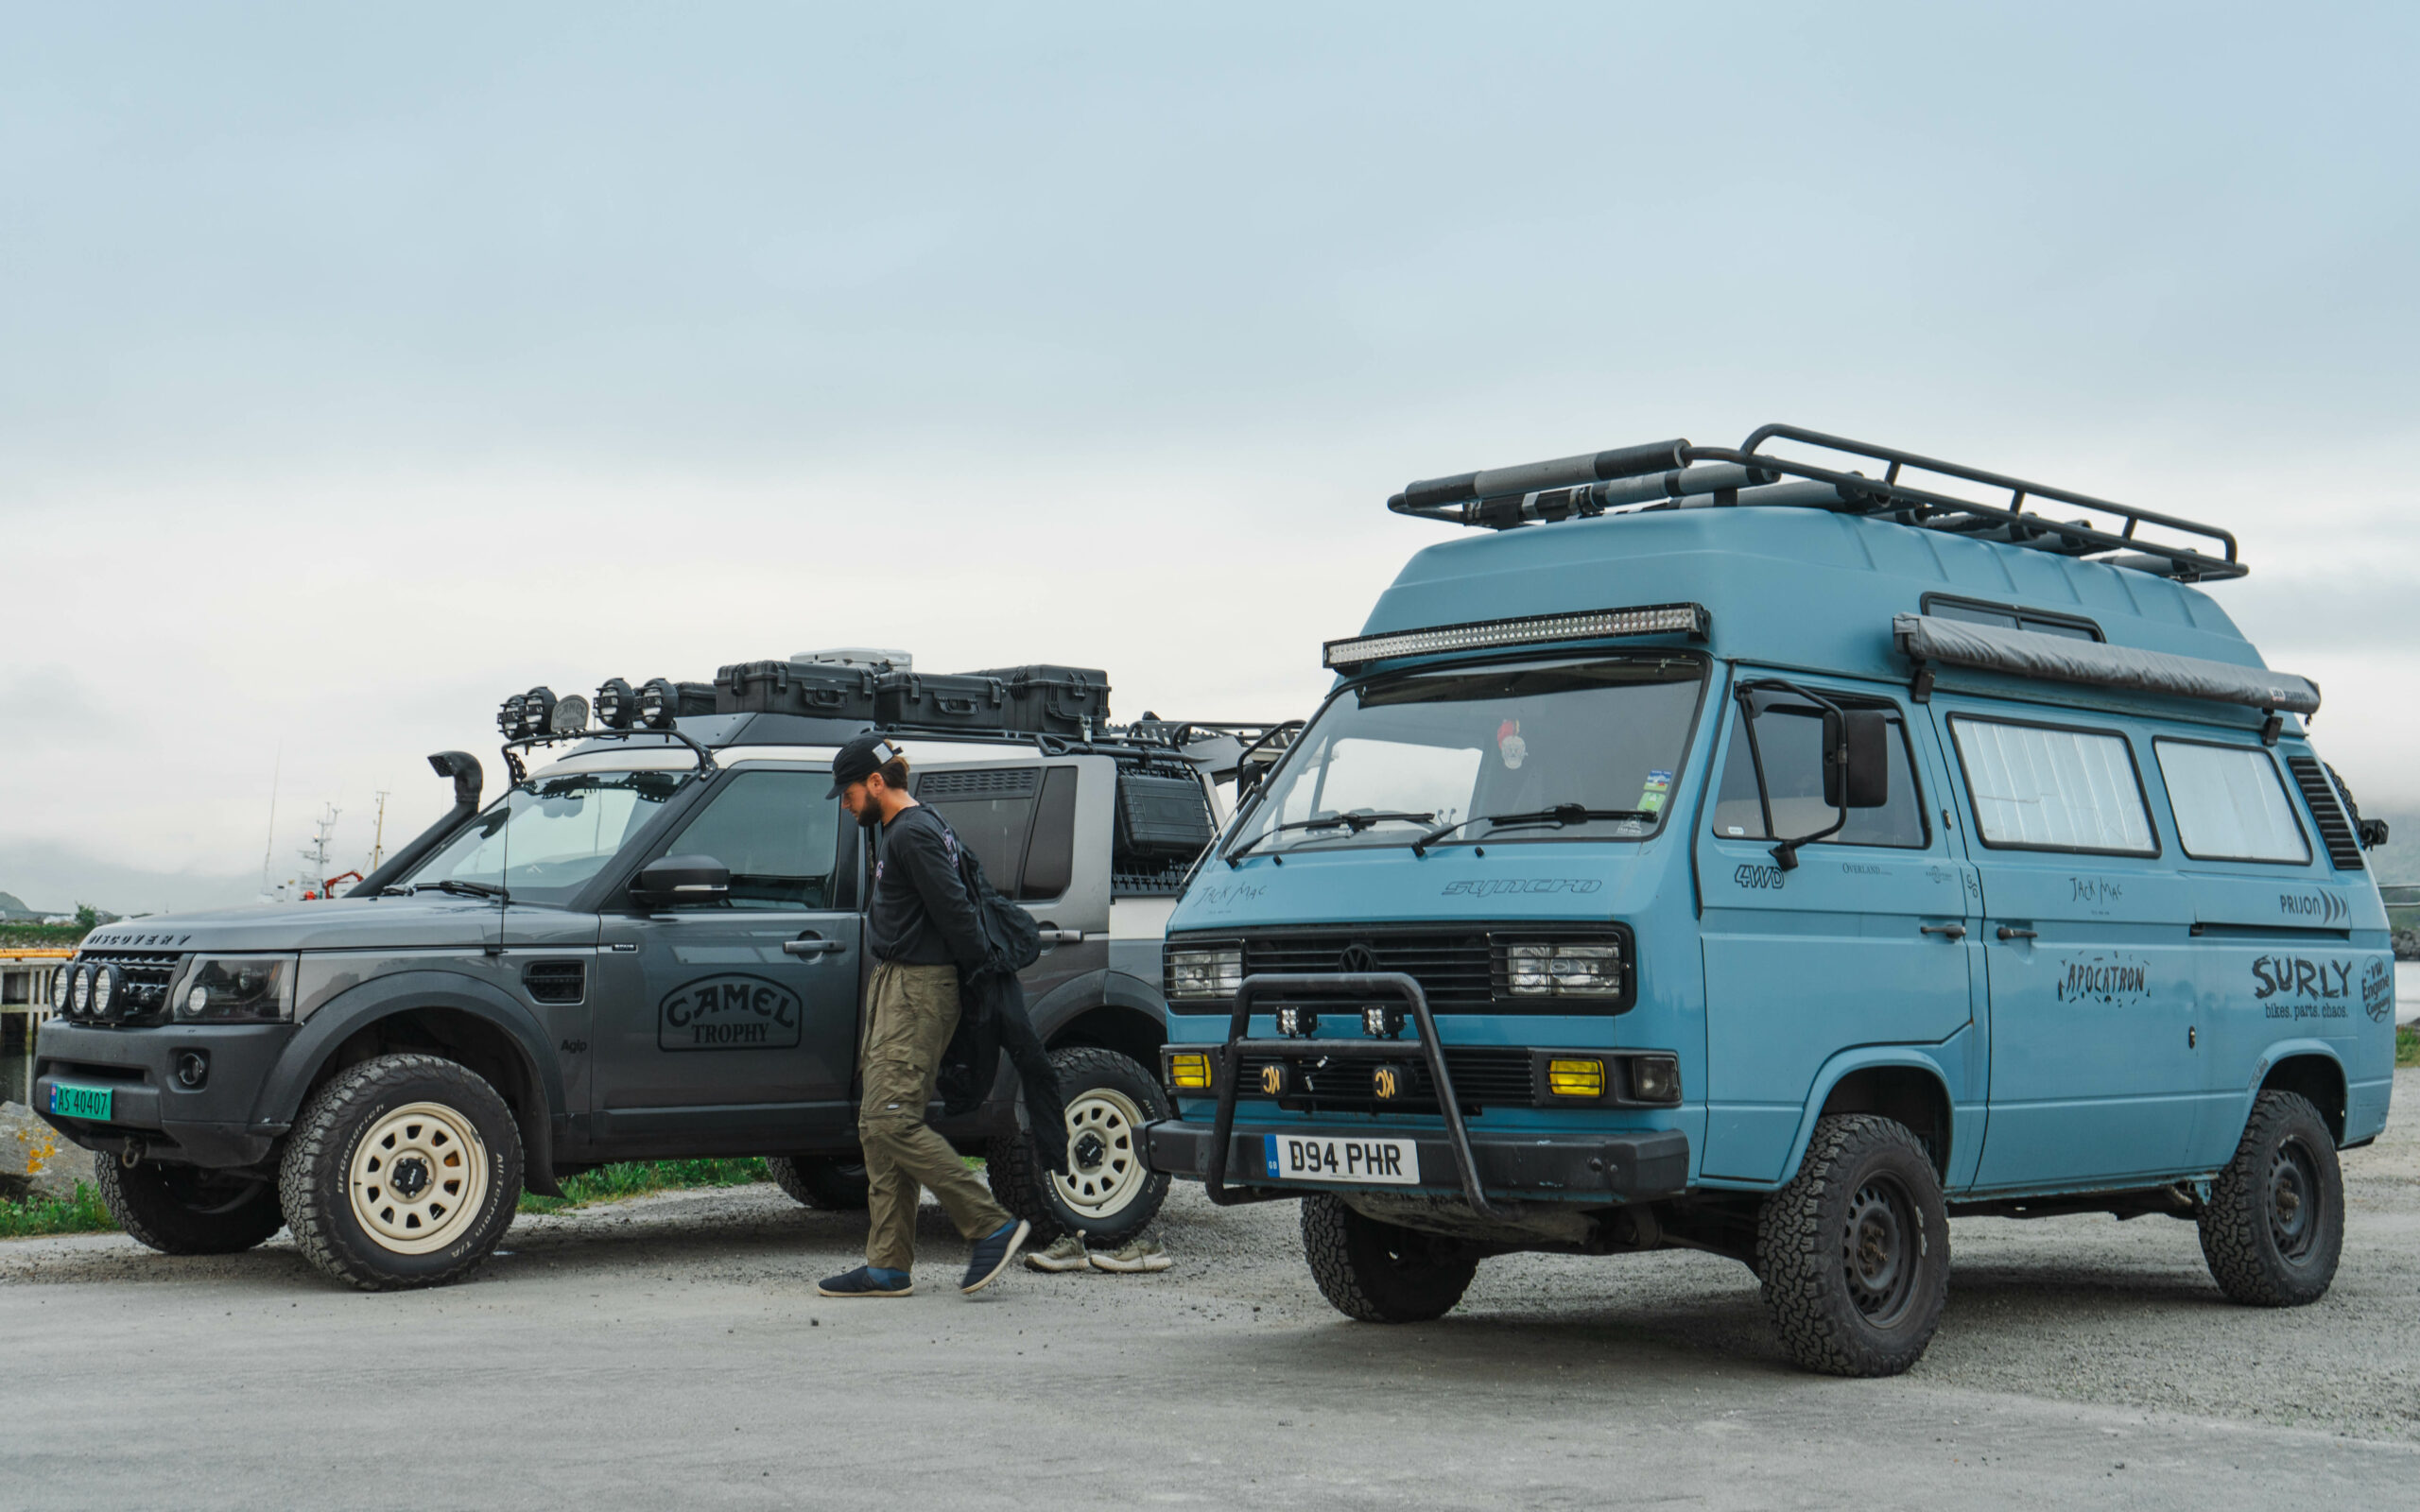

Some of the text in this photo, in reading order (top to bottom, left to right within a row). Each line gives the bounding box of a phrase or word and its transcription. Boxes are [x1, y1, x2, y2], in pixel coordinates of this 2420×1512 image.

[1442, 879, 1602, 898] syncro
[1735, 864, 1785, 889] 4WD
[2279, 895, 2322, 916] PRIJON
[87, 934, 191, 946] DISCOVERY
[2066, 963, 2145, 993] APOCATRON
[2252, 954, 2352, 1001] SURLY
[2361, 974, 2390, 1002] Engine
[666, 984, 795, 1029] CAMEL
[2265, 1003, 2349, 1022] bikes. parts. chaos.
[692, 1022, 769, 1043] TROPHY
[561, 1040, 587, 1054] Agip
[58, 1089, 107, 1115] AS 40407
[337, 1103, 385, 1194] BFGoodrich
[1288, 1140, 1403, 1177] D94 PHR
[475, 1152, 504, 1237] All-Terrain
